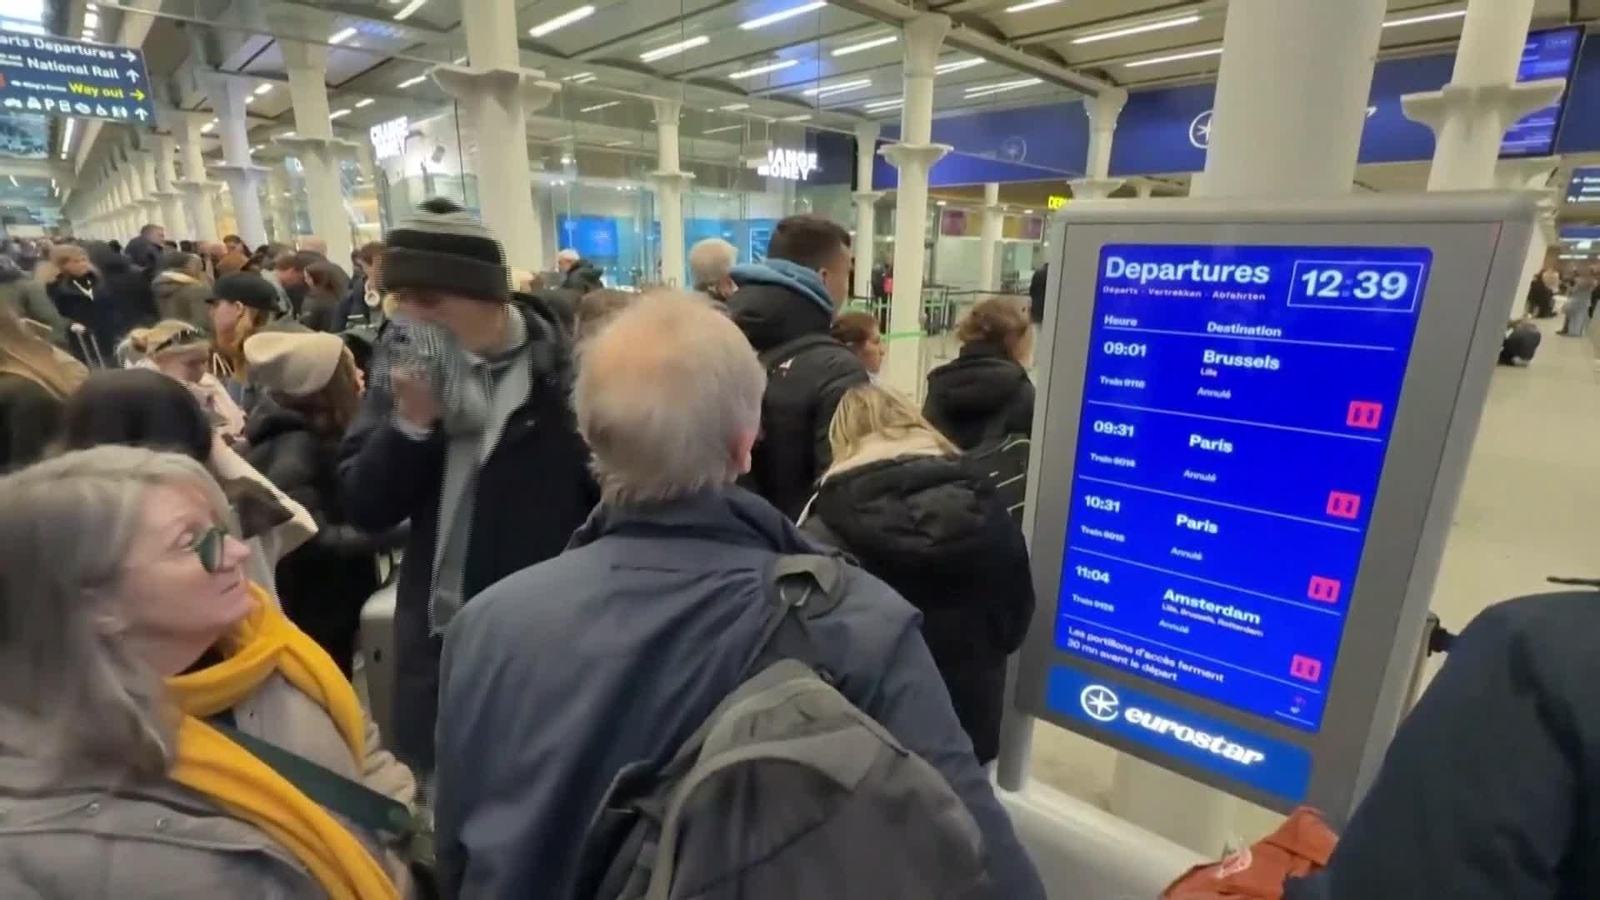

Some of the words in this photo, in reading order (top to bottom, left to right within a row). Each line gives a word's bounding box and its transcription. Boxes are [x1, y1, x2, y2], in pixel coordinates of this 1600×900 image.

[34, 38, 115, 59] Departures
[27, 56, 89, 76] National
[92, 66, 120, 79] Rail
[68, 81, 99, 98] Way
[102, 88, 124, 98] out
[1106, 256, 1270, 284] Departures
[1301, 270, 1408, 300] 12:39
[1104, 315, 1138, 326] Heure
[1206, 321, 1282, 338] Destination
[1104, 342, 1146, 358] 09:01
[1203, 350, 1280, 370] Brussels
[1200, 368, 1218, 378] Lille
[1197, 386, 1232, 400] Annulé
[1094, 420, 1134, 438] 09:31
[1189, 434, 1233, 453] Paris
[1084, 494, 1120, 513] 10:31
[1176, 514, 1219, 534] Paris
[1075, 565, 1110, 584] 11:04
[1163, 588, 1260, 624] Amsterdam
[1068, 626, 1086, 638] Les
[1087, 632, 1134, 654] portillons
[1136, 648, 1176, 668] d'accès
[1178, 660, 1224, 682] ferment
[1100, 649, 1128, 666] avant
[1130, 658, 1140, 669] le
[1142, 661, 1178, 681] départ
[1124, 706, 1265, 766] eurostar
